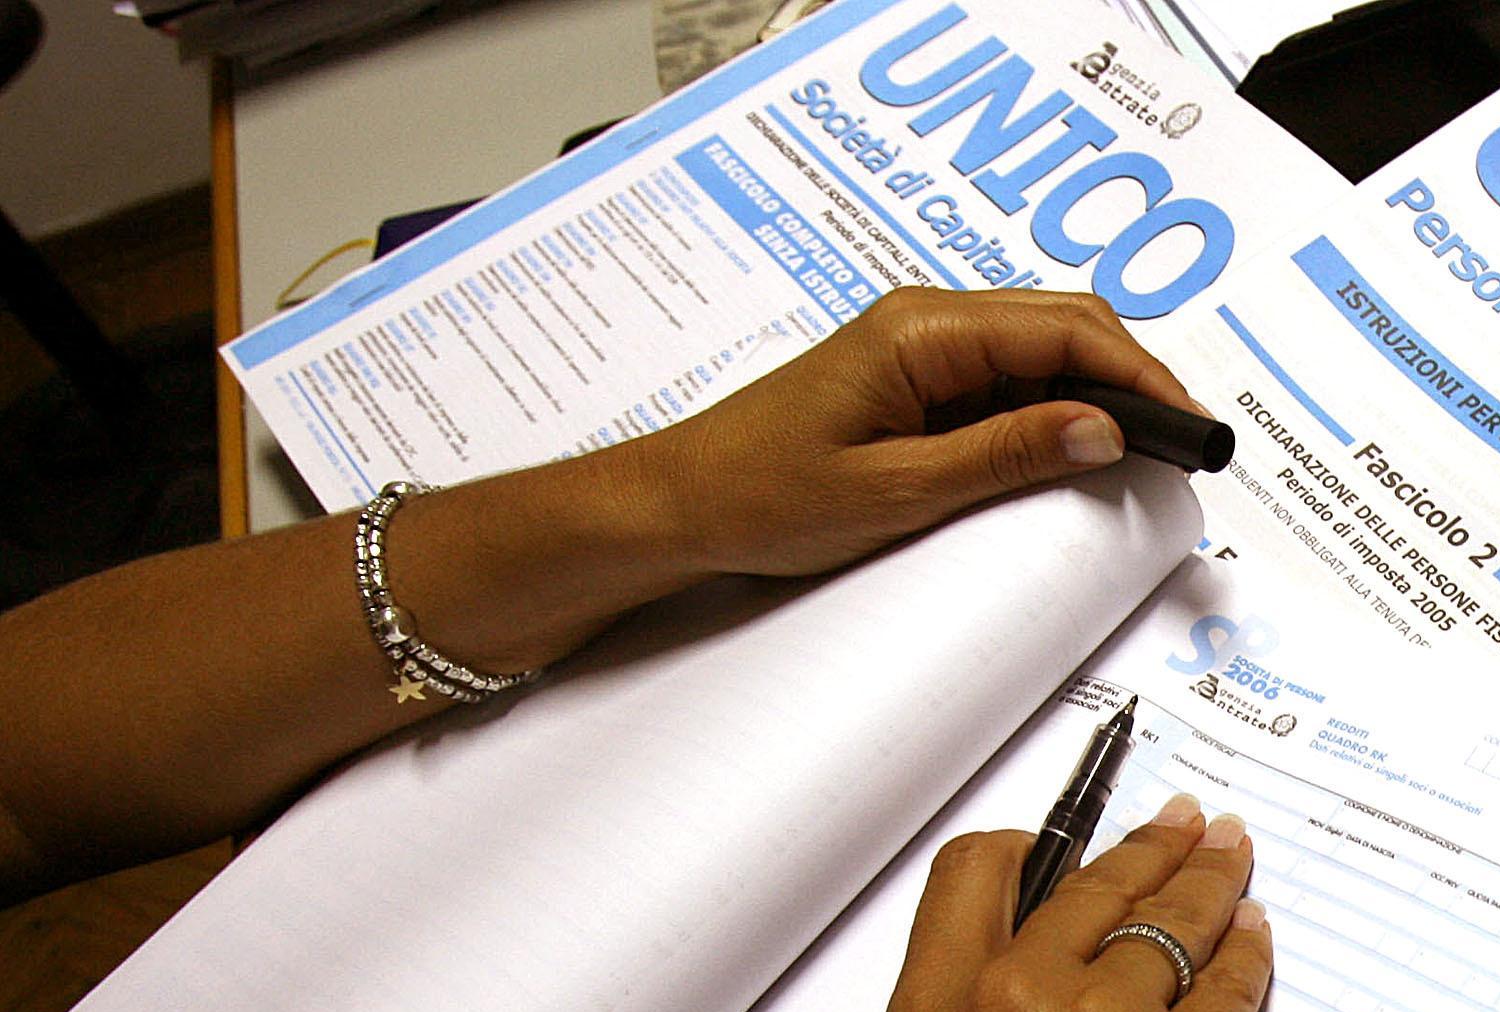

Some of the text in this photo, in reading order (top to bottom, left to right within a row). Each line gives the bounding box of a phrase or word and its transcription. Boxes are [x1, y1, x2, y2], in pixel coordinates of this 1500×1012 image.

[790, 79, 902, 175] Società
[884, 171, 935, 199] di
[857, 2, 1236, 320] UNICO
[704, 142, 781, 214] FASCICOLO
[775, 211, 854, 284] COMPLETO
[847, 283, 876, 306] DI
[753, 223, 806, 273] SENZA
[800, 268, 860, 324] ISTRUZ
[821, 210, 856, 243] Periodo
[853, 240, 869, 254] di
[1336, 280, 1465, 400] ISTRUZIONI
[1228, 459, 1275, 505] RIBUENTI
[1270, 502, 1296, 527] NON
[1292, 524, 1348, 575] OBBLIGATI
[1343, 574, 1372, 600] ALLA
[1370, 596, 1411, 637] TENUTA
[1236, 390, 1360, 508] DICHIARAZIONE
[1353, 504, 1407, 552] DELLE
[1401, 548, 1481, 617] PERSONE
[1277, 467, 1457, 632] Periodo di imposta 2005
[1353, 442, 1498, 569] Fascicolo 2
[1140, 728, 1160, 744] RK1
[1222, 663, 1281, 700] 2006
[1272, 677, 1285, 687] DI
[1284, 682, 1326, 704] PERSONE
[1327, 717, 1370, 740] REDDITI
[1309, 739, 1328, 752] Dati
[1330, 749, 1364, 766] relativi
[1363, 760, 1373, 769] ai
[1375, 765, 1407, 785] singoli
[1408, 778, 1430, 793] soci
[1438, 792, 1484, 816] associati
[1318, 729, 1389, 763] QUADRO RK
